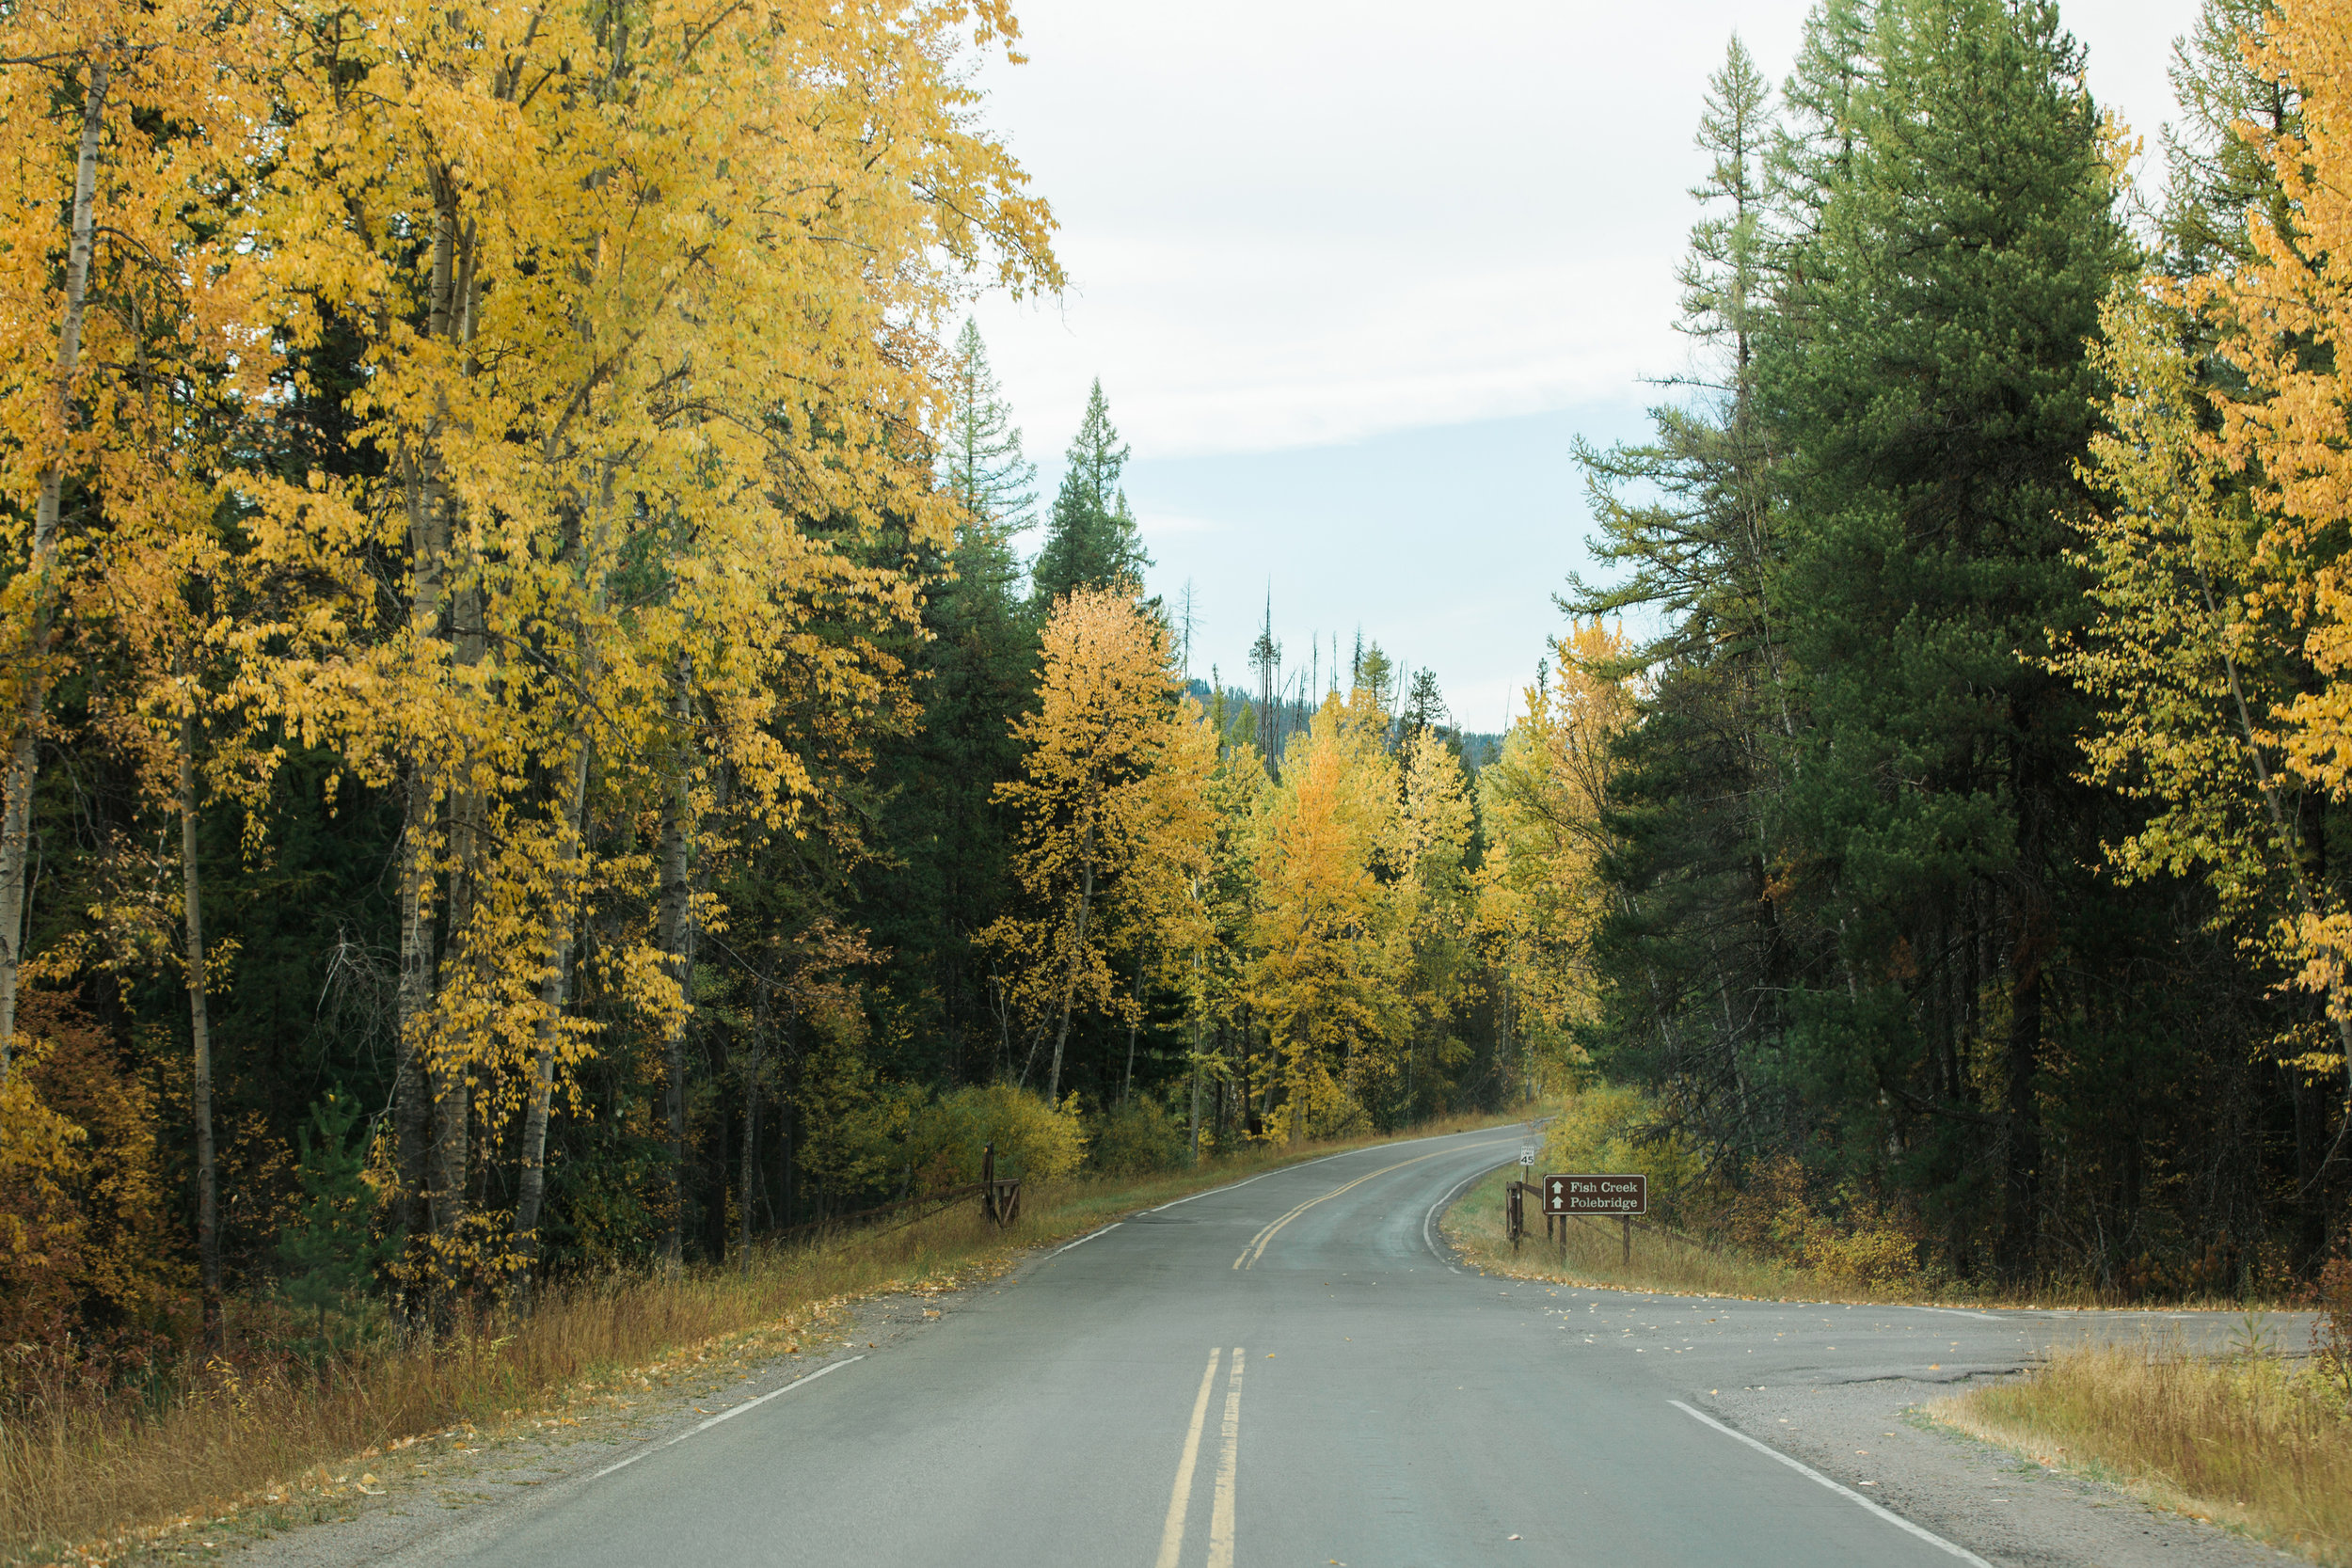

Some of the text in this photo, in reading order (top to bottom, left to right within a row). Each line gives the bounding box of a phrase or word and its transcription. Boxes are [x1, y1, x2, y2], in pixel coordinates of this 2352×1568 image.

[1570, 1181, 1638, 1193] Fish Creek
[1570, 1196, 1638, 1211] Polebridge
